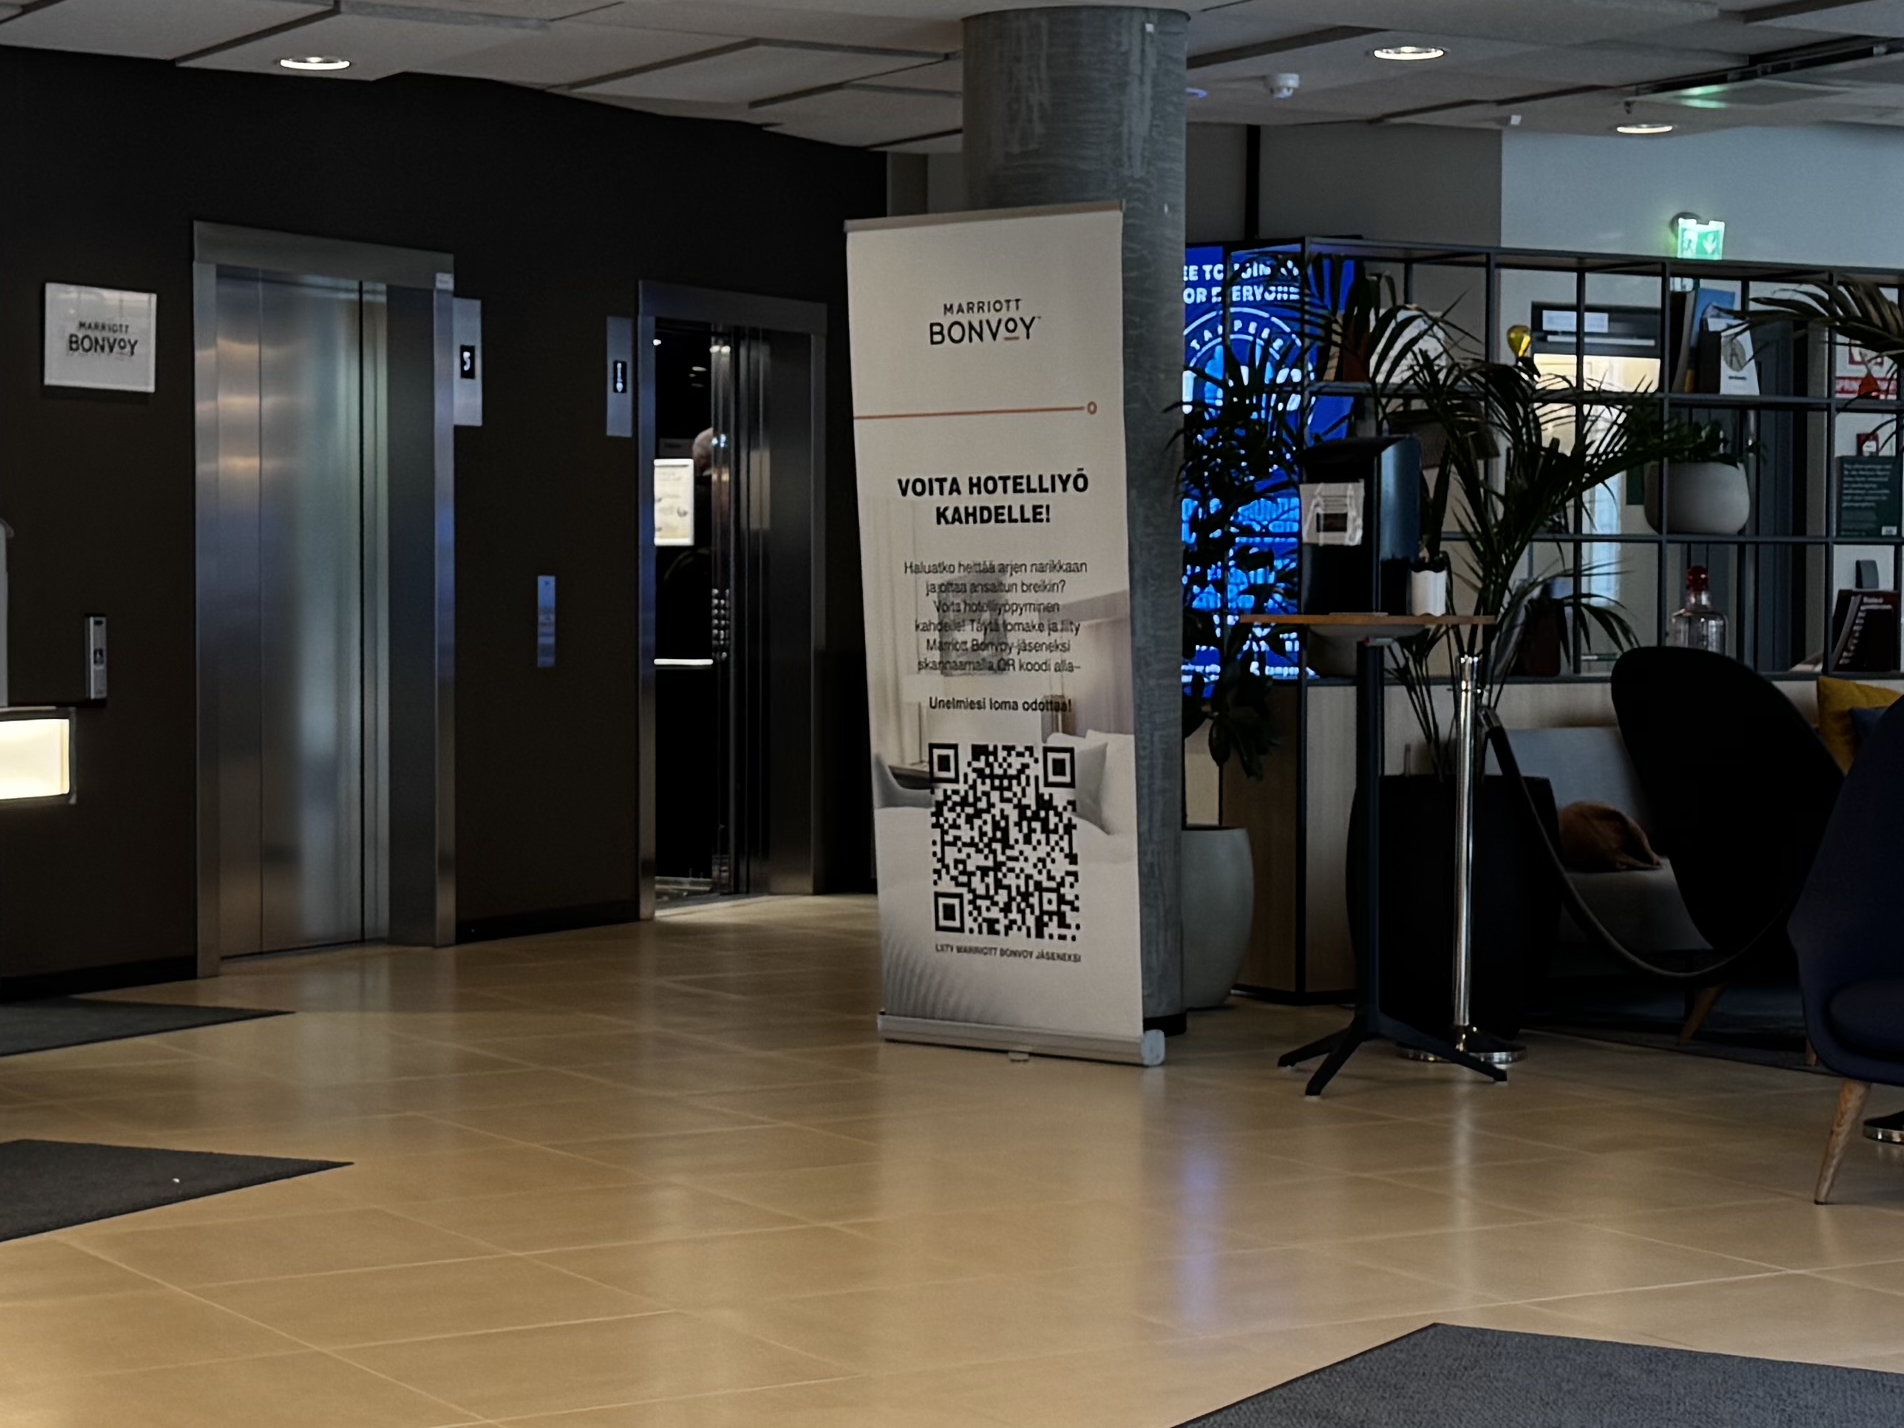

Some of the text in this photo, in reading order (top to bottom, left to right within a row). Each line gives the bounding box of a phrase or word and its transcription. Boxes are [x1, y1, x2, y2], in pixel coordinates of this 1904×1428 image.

[943, 298, 1022, 316] MARRIOTT
[79, 321, 129, 334] MARRIOTT
[68, 333, 138, 356] BONVOY
[897, 468, 1089, 497] VOITA HOTELLIYÖ
[936, 504, 1051, 525] KAHDELLE!
[904, 561, 955, 574] Haluatko
[998, 561, 1027, 576] arjen
[929, 696, 986, 710] Unelmiesi
[989, 697, 1019, 711] loma
